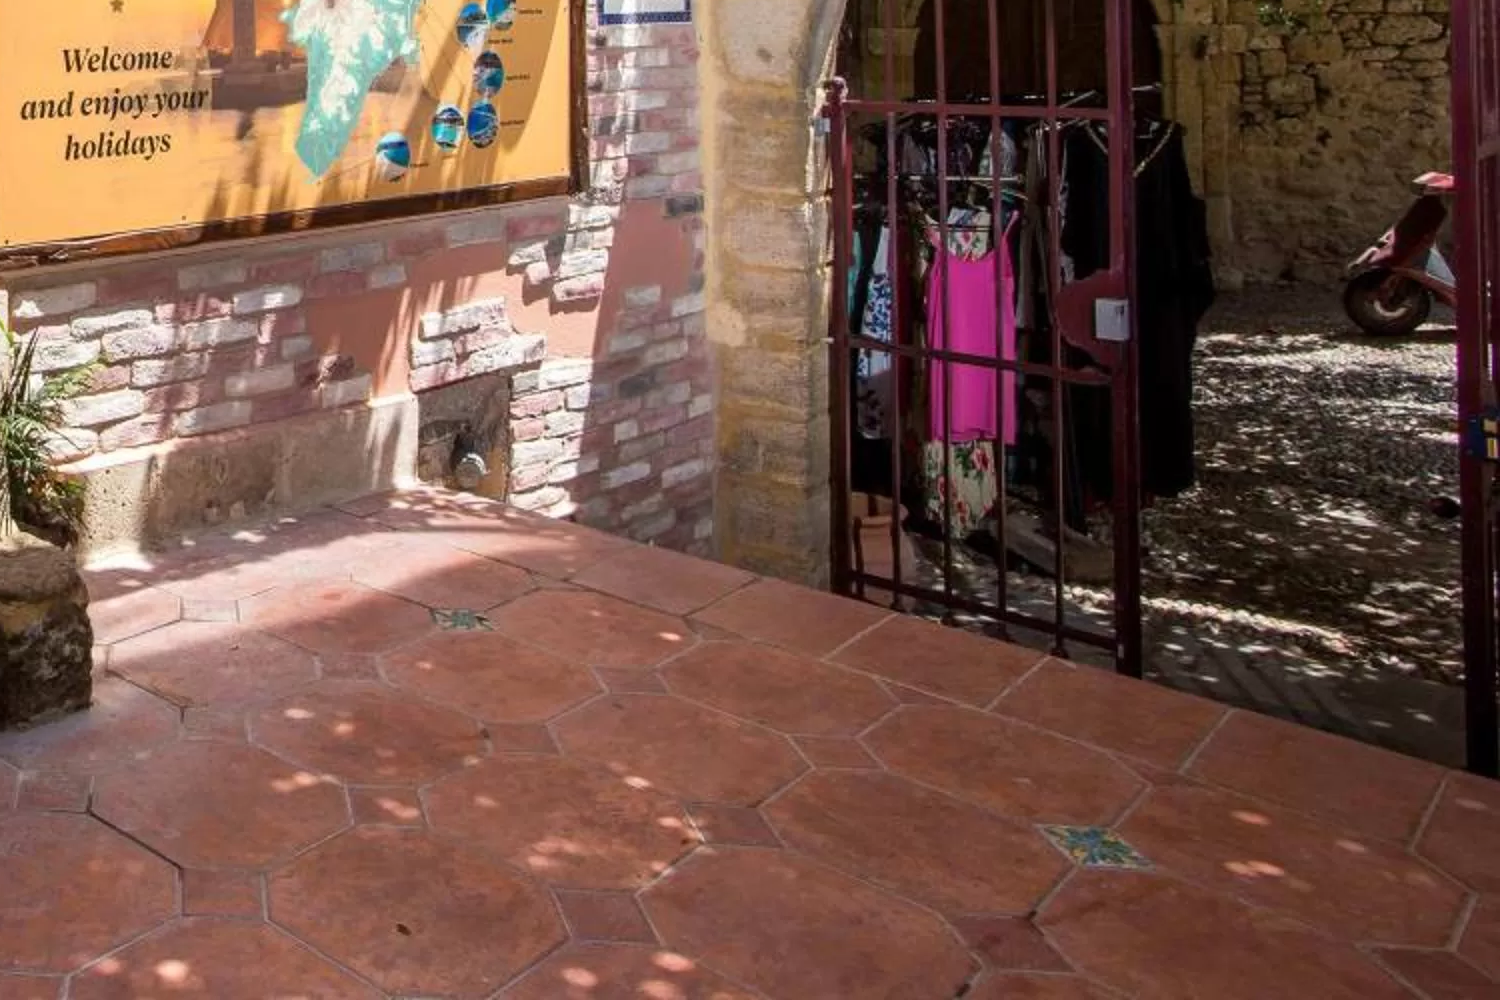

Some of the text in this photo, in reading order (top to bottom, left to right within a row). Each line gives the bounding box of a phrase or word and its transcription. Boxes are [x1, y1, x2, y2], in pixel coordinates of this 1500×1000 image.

[61, 47, 173, 73] Welcome
[20, 87, 210, 121] and enjoy your
[64, 130, 172, 162] holidays
